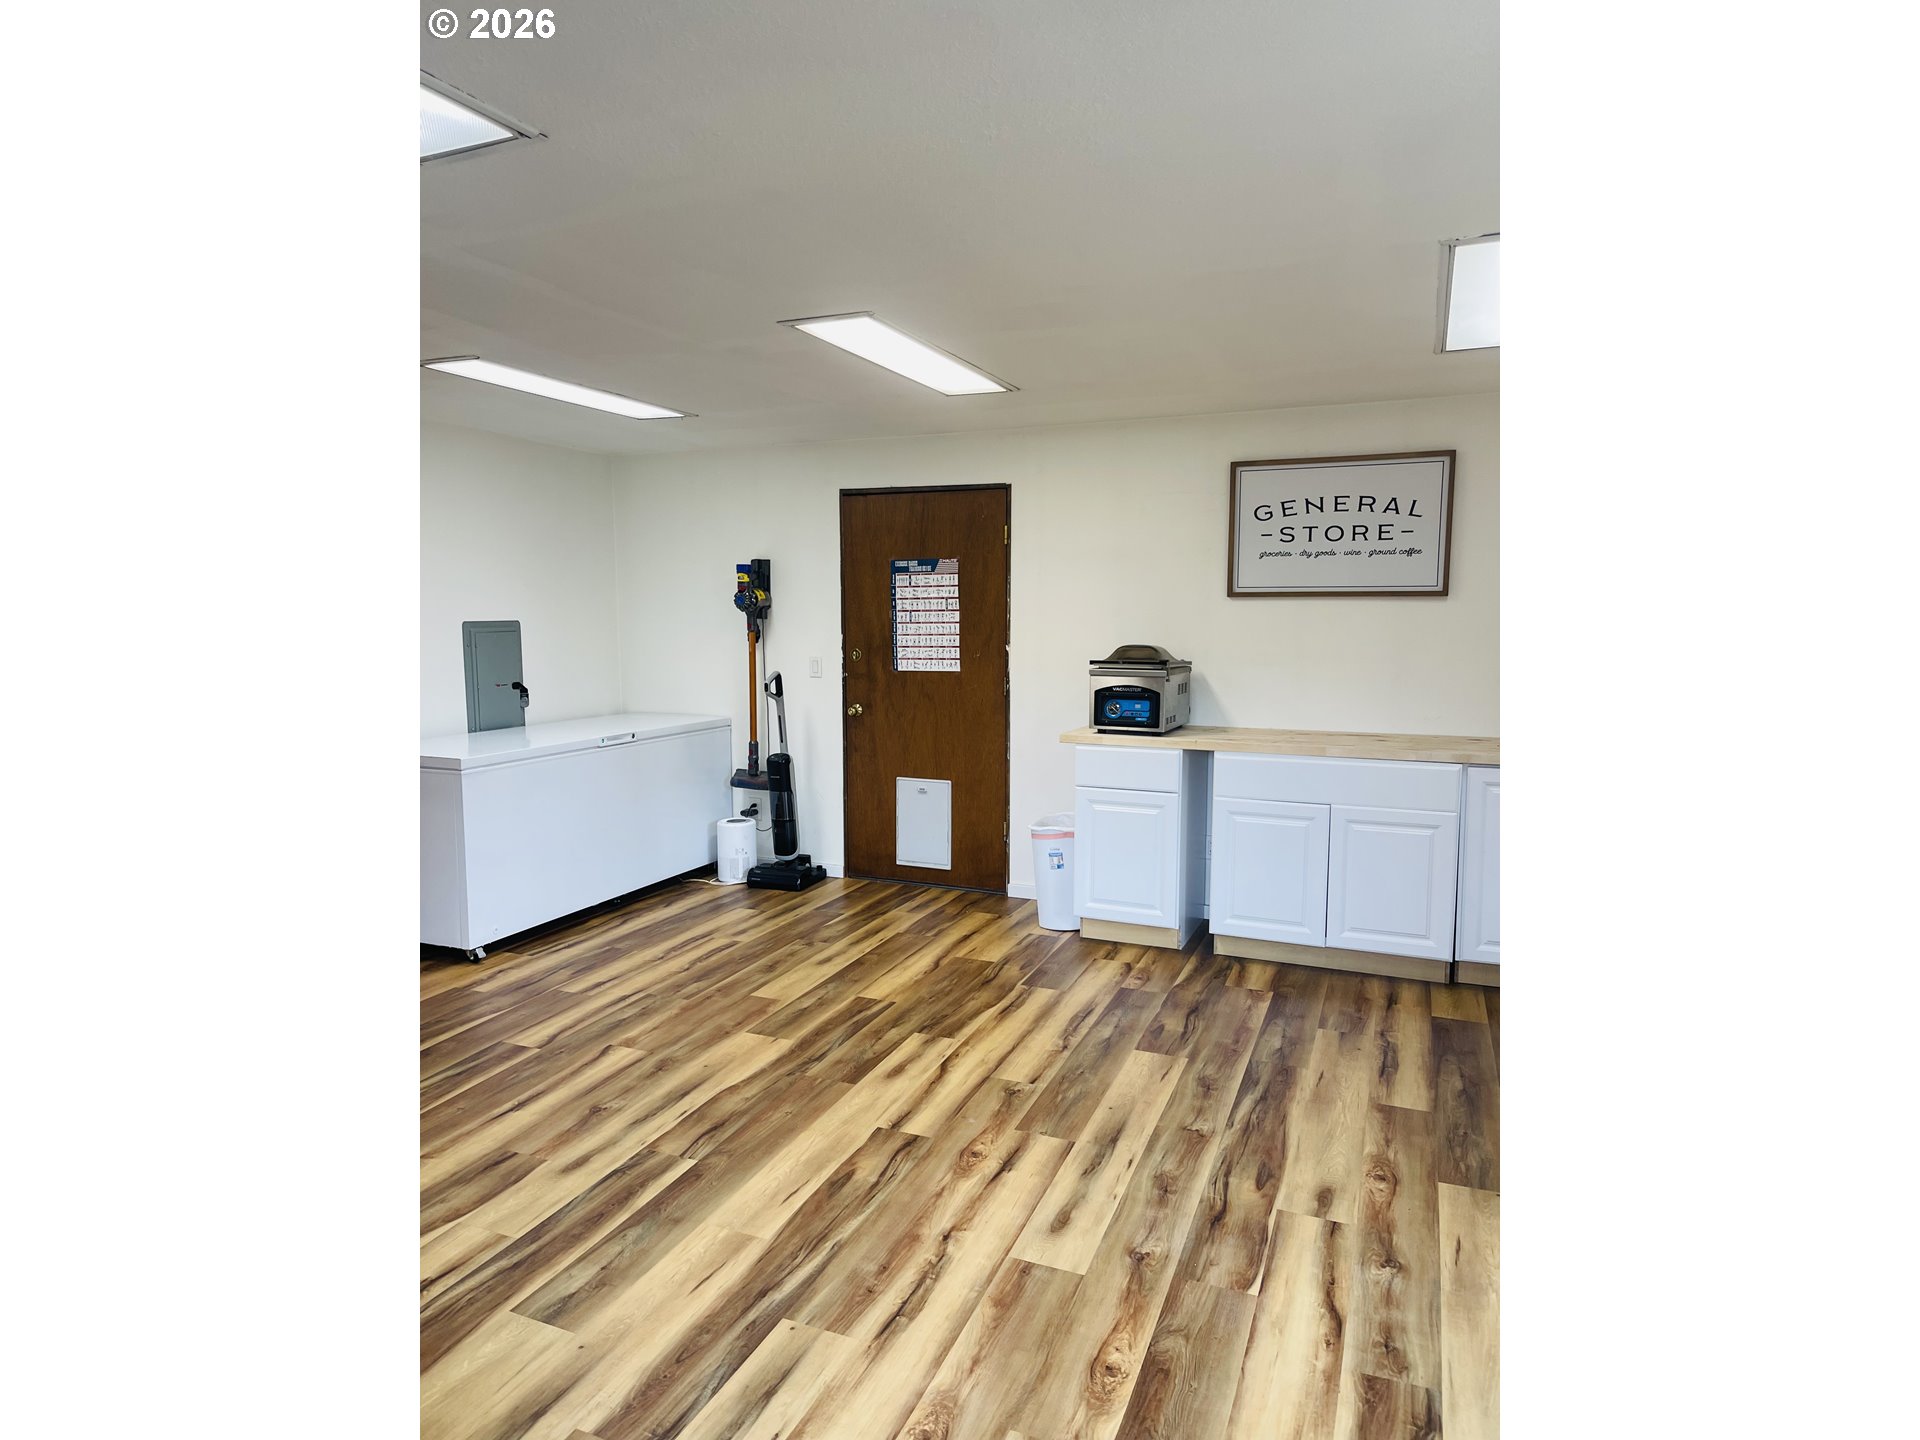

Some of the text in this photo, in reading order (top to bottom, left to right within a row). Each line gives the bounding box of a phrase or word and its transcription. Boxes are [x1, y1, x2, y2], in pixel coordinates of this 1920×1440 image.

[1254, 495, 1423, 521] GENERAL
[1259, 547, 1423, 559] groceries dry goods wine ground coffee
